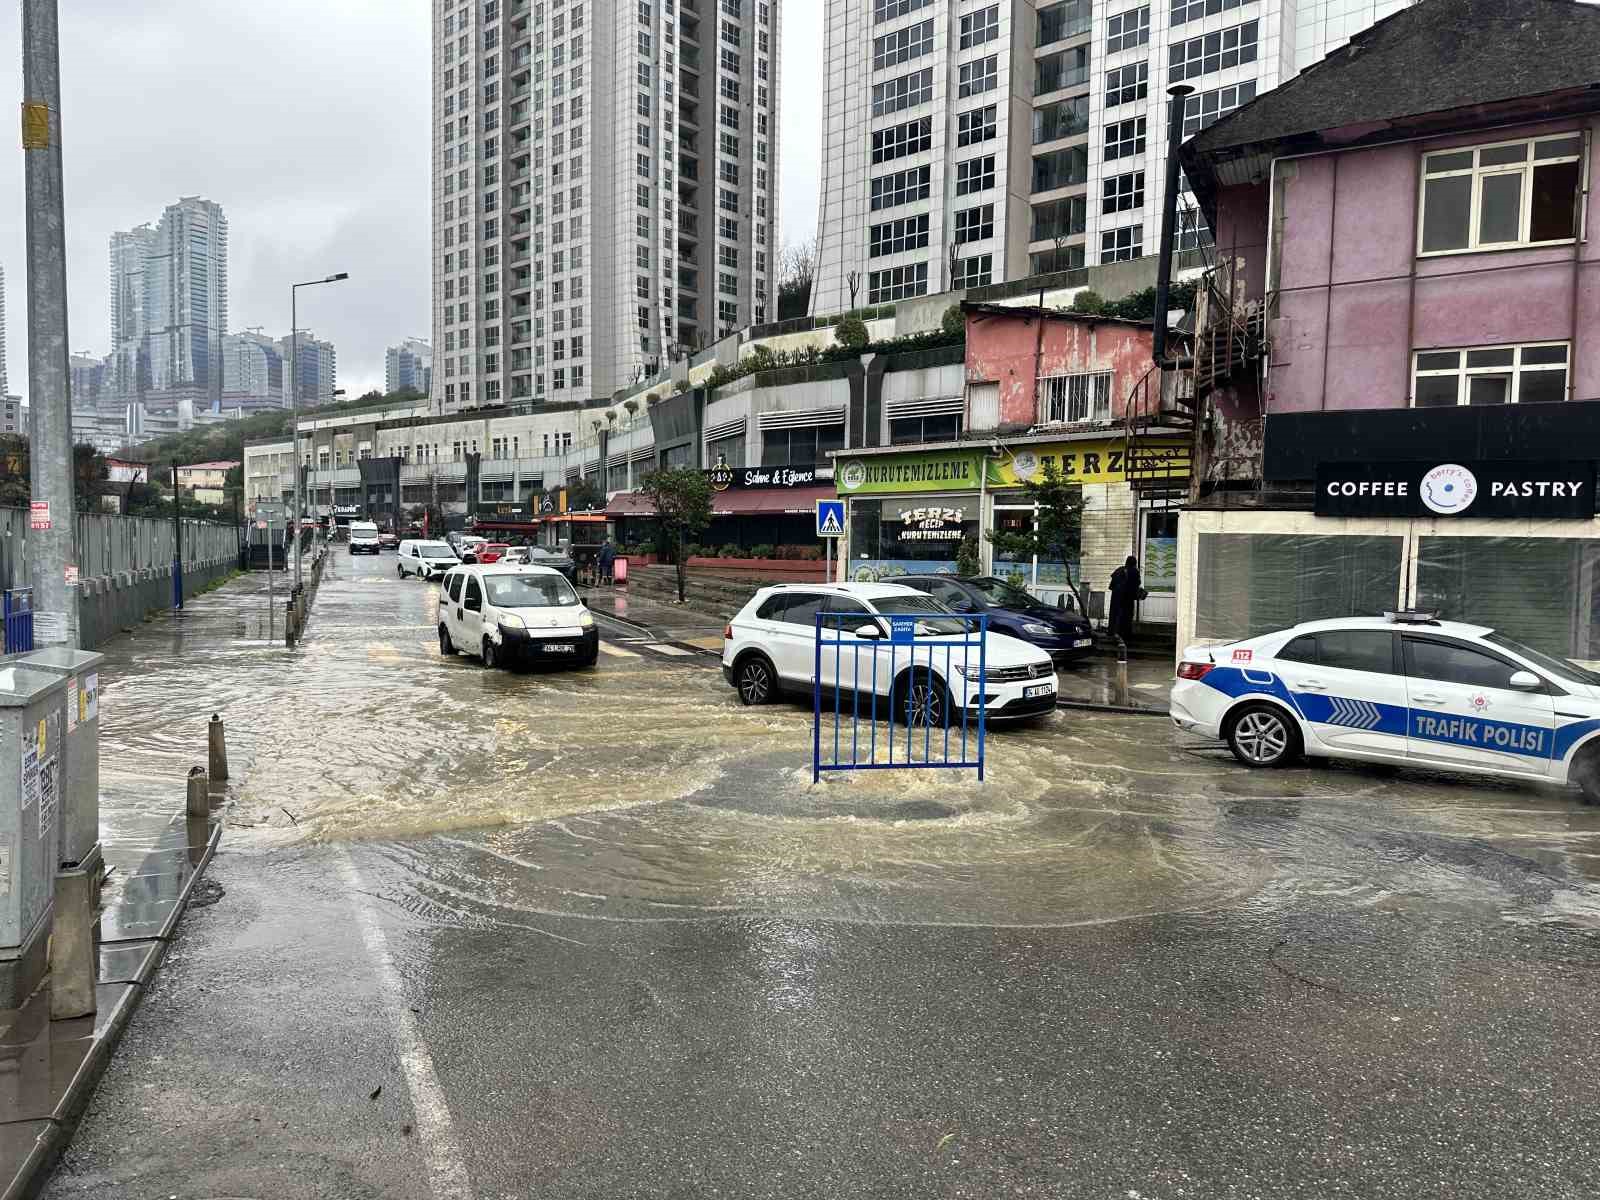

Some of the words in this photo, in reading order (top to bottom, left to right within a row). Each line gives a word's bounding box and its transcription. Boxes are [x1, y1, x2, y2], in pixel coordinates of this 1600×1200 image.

[744, 470, 770, 485] Sahne
[772, 470, 781, 485] &
[782, 469, 813, 486] Eğlence
[865, 460, 969, 483] KURUTEMİZLEME
[1327, 481, 1409, 497] COFFEE
[1491, 481, 1583, 497] PASTRY
[1233, 651, 1250, 660] 112
[1416, 716, 1478, 742] TRAFİK
[1483, 725, 1545, 752] POLİSİ
